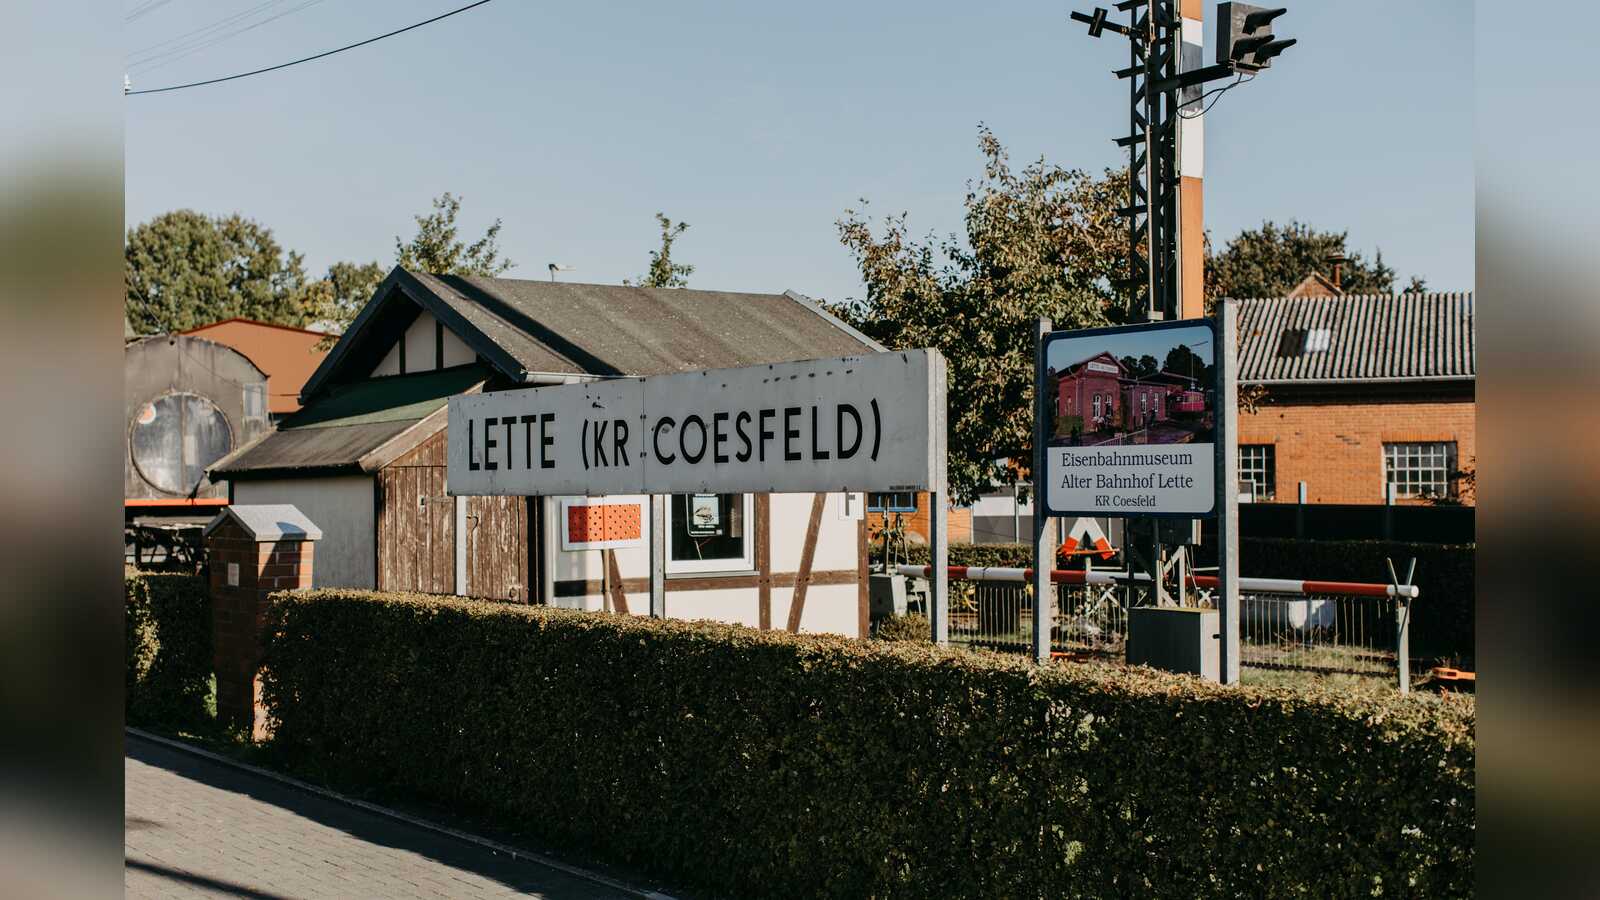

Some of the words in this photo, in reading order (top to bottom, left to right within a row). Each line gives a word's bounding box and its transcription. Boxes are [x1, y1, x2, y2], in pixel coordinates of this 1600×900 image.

[468, 412, 556, 471] LETTE
[582, 417, 630, 471] (KR
[653, 396, 881, 465] COESFELD)
[1062, 452, 1193, 467] Eisenbahnmuseum
[1061, 474, 1092, 489] Alter
[1096, 473, 1155, 489] Bahnhof
[1159, 473, 1193, 488] Lette
[1095, 495, 1110, 507] KR
[1113, 495, 1156, 507] Coesfeld
